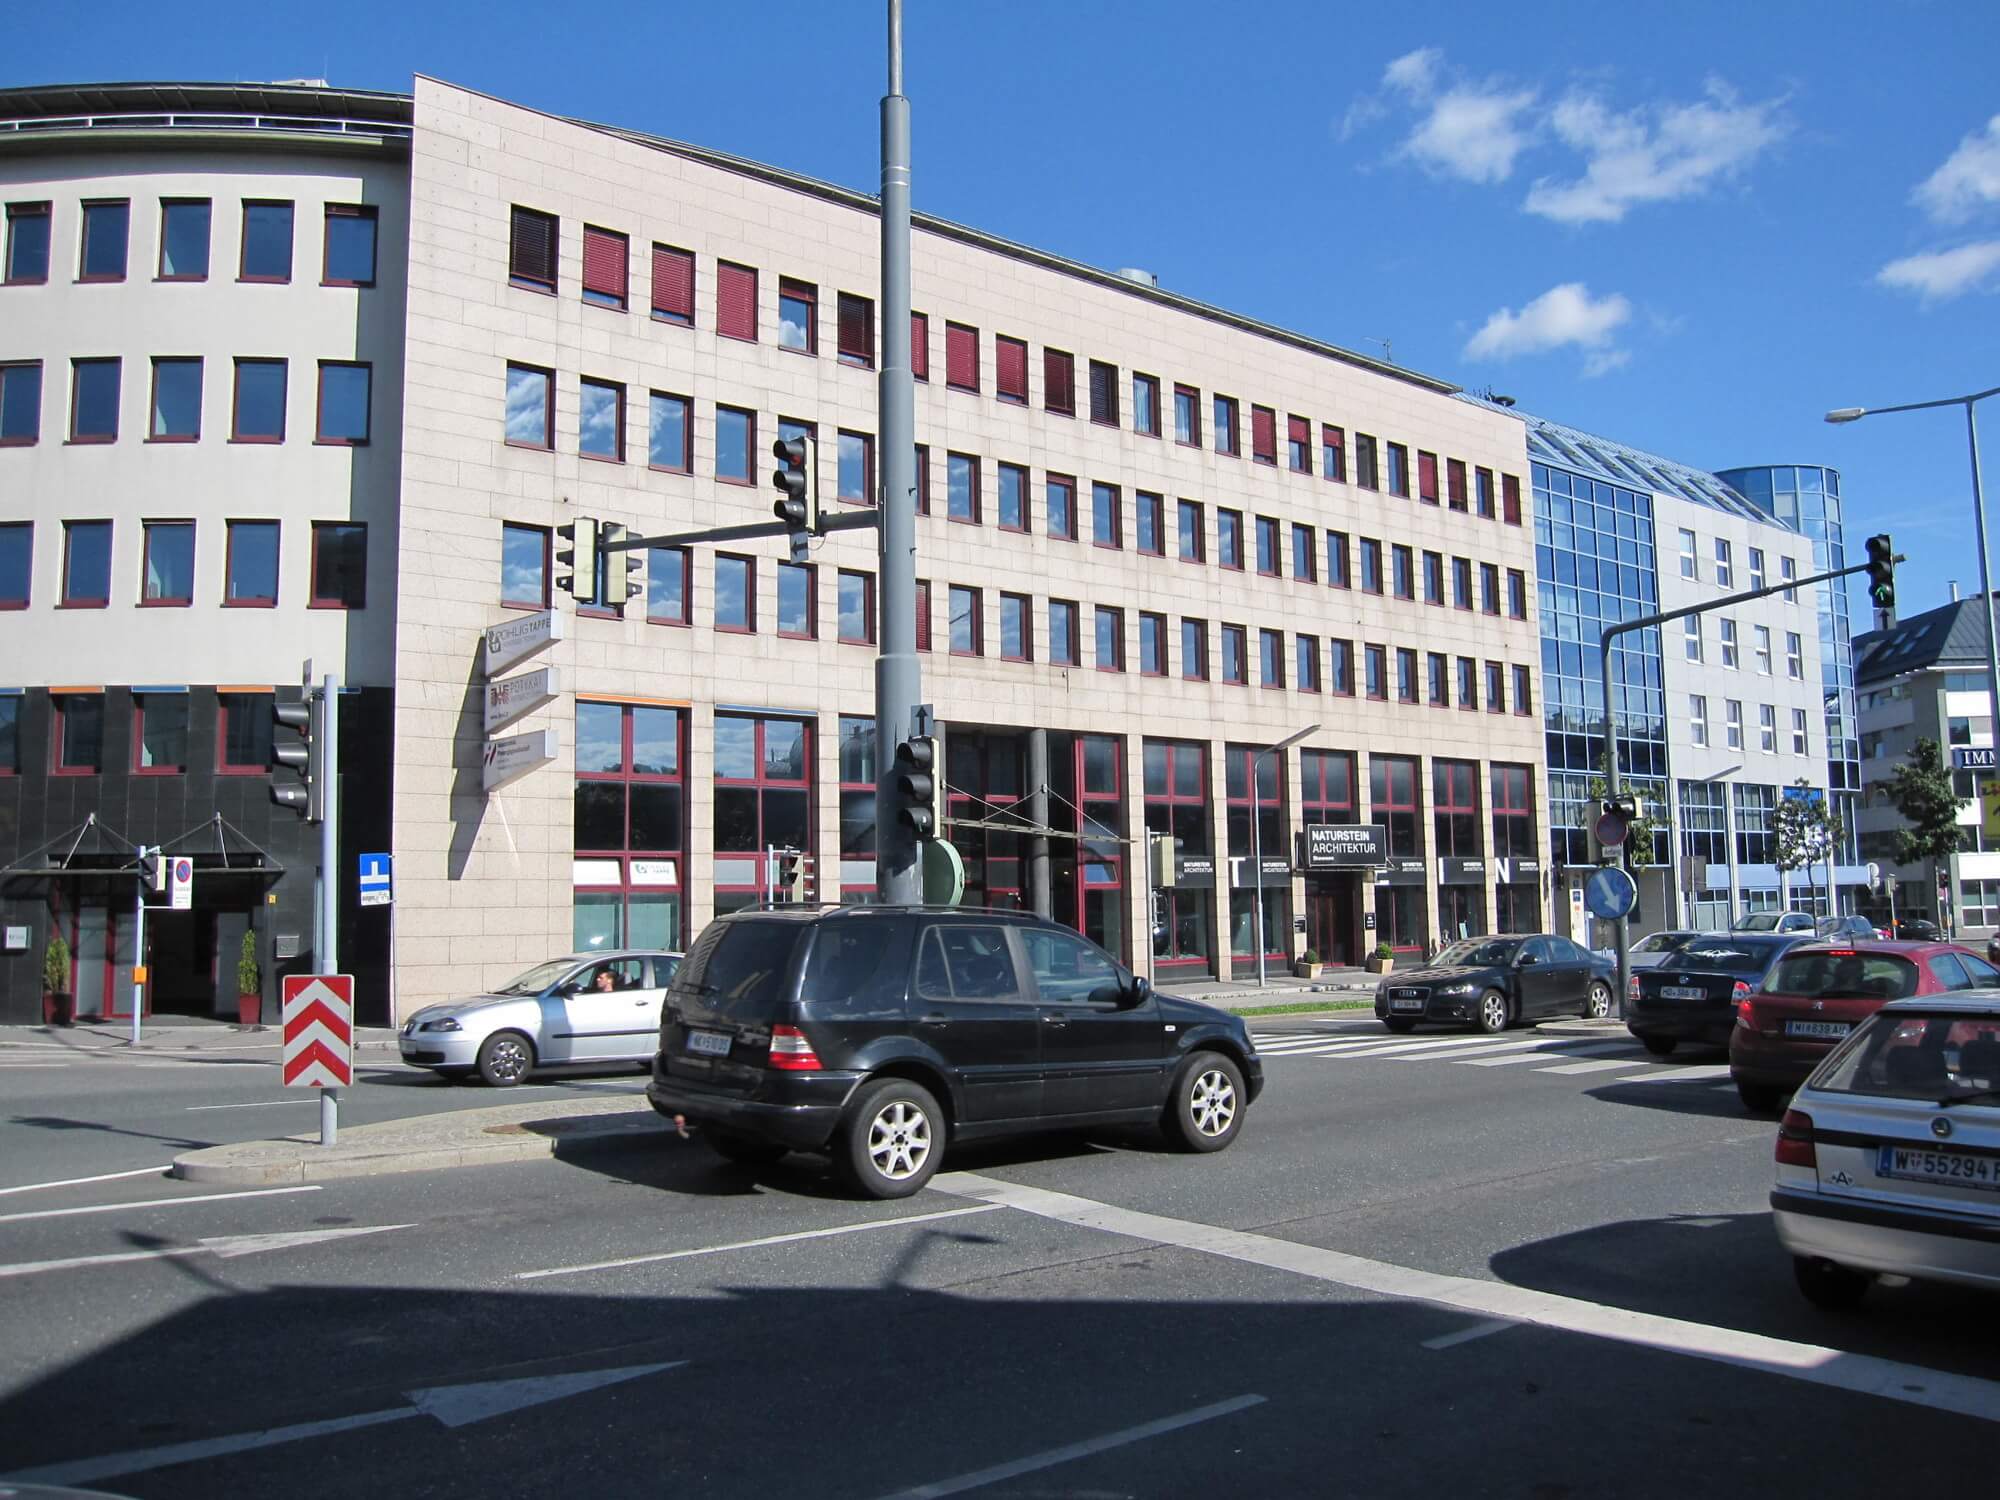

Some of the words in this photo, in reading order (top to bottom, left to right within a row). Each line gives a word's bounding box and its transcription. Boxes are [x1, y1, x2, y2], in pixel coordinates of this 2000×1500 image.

[1311, 830, 1370, 841] NATURSTEIN
[1312, 843, 1377, 853] ARCHITEKTUR
[1494, 857, 1511, 884] N
[1895, 1150, 1908, 1169] W
[1923, 1153, 1988, 1180] 55294
